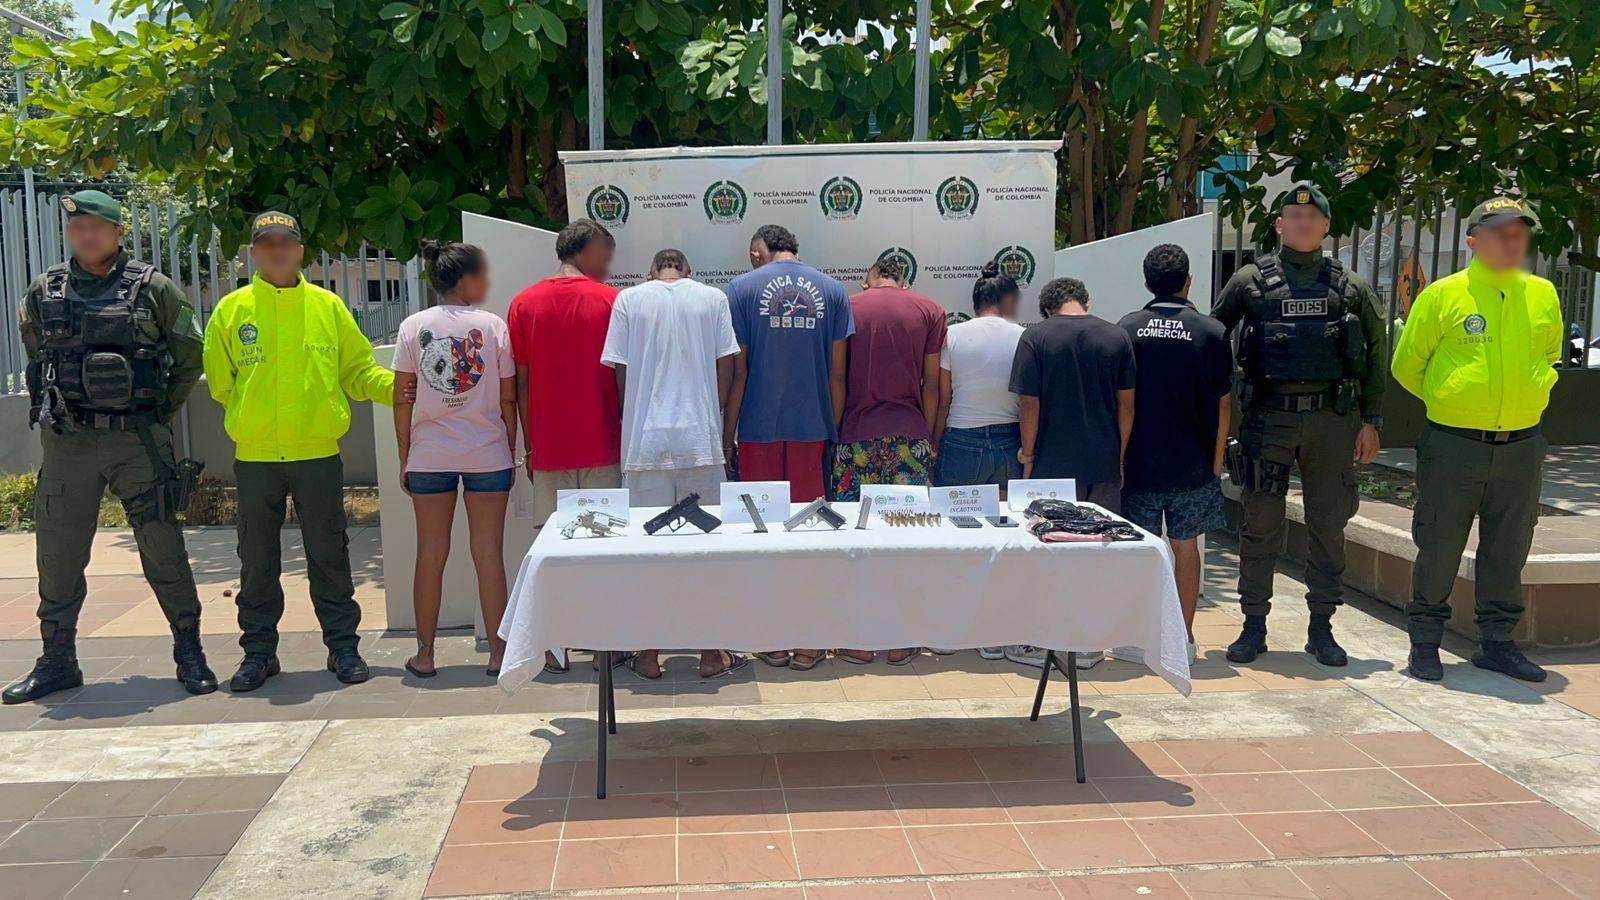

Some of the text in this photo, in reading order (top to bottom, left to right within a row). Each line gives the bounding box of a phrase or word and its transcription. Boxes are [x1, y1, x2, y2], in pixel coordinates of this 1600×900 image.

[633, 193, 697, 202] POLICÍA NACIONAL
[772, 198, 808, 206] COLOMBIA
[255, 215, 295, 229] POLICIA
[695, 269, 723, 277] POLICÍA
[925, 264, 952, 272] POLICÍA
[759, 274, 825, 319] NAUTICA SAILING
[1287, 300, 1323, 314] GOES
[1147, 318, 1184, 330] ATLETA
[1136, 327, 1193, 341] COMERCIAL
